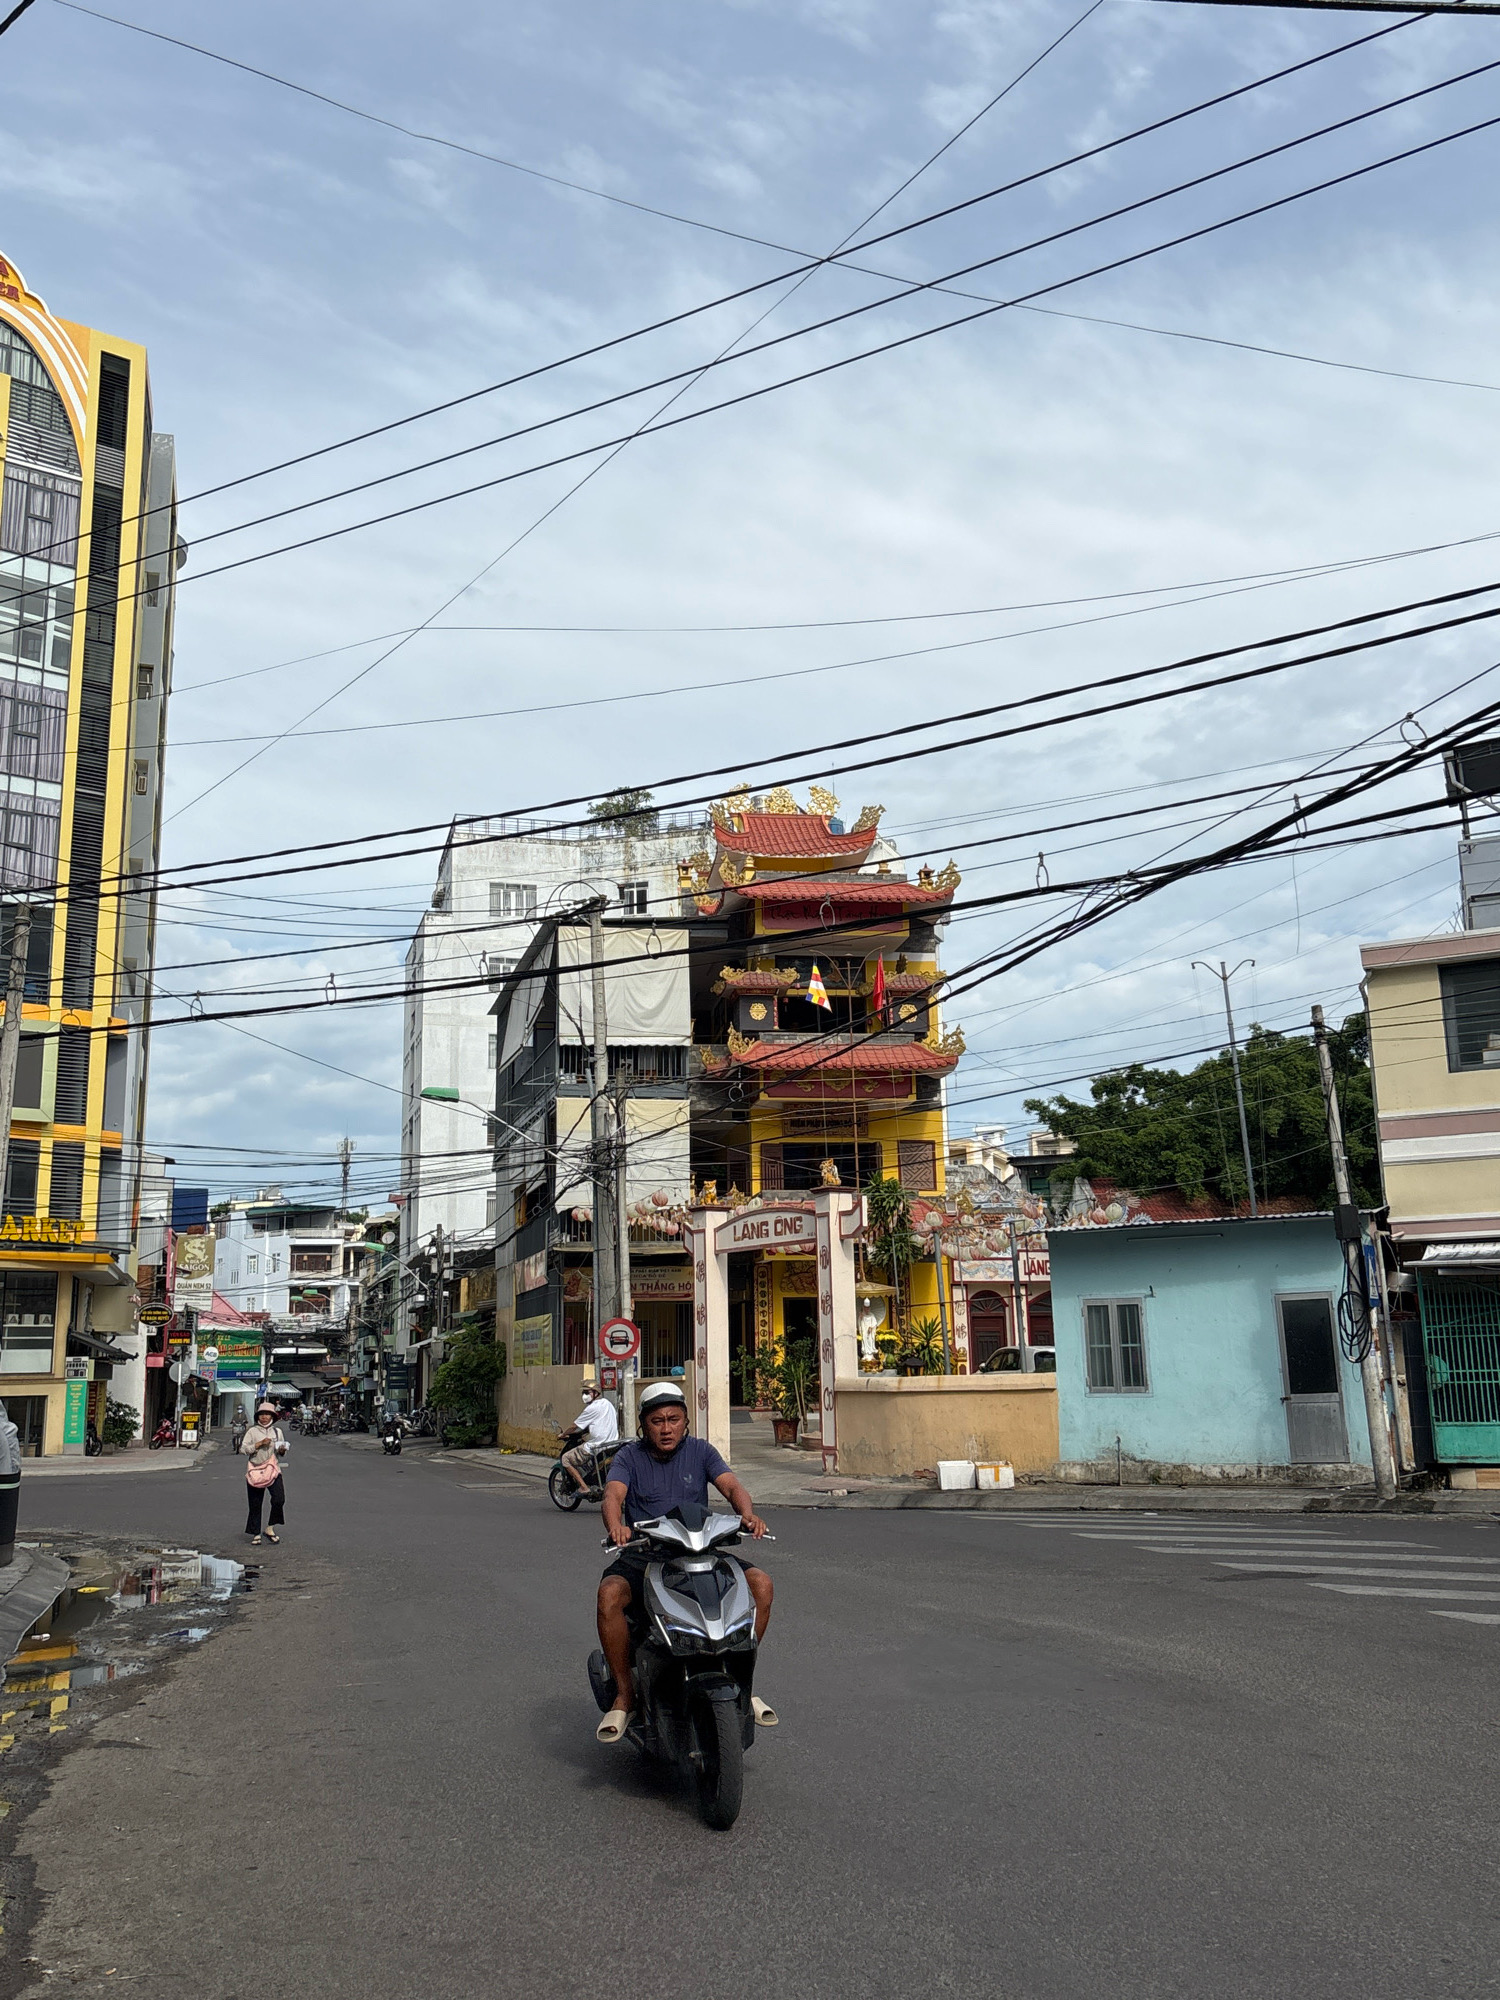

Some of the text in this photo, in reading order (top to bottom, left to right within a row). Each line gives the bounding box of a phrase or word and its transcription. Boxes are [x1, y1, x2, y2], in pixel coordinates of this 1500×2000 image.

[733, 1215, 804, 1242] LĂNG ÔNG
[179, 1263, 211, 1271] SAIGON
[1023, 1256, 1051, 1276] LĂNG
[193, 1282, 205, 1290] NEM
[205, 1350, 218, 1358] ACB
[201, 1370, 214, 1380] 52
